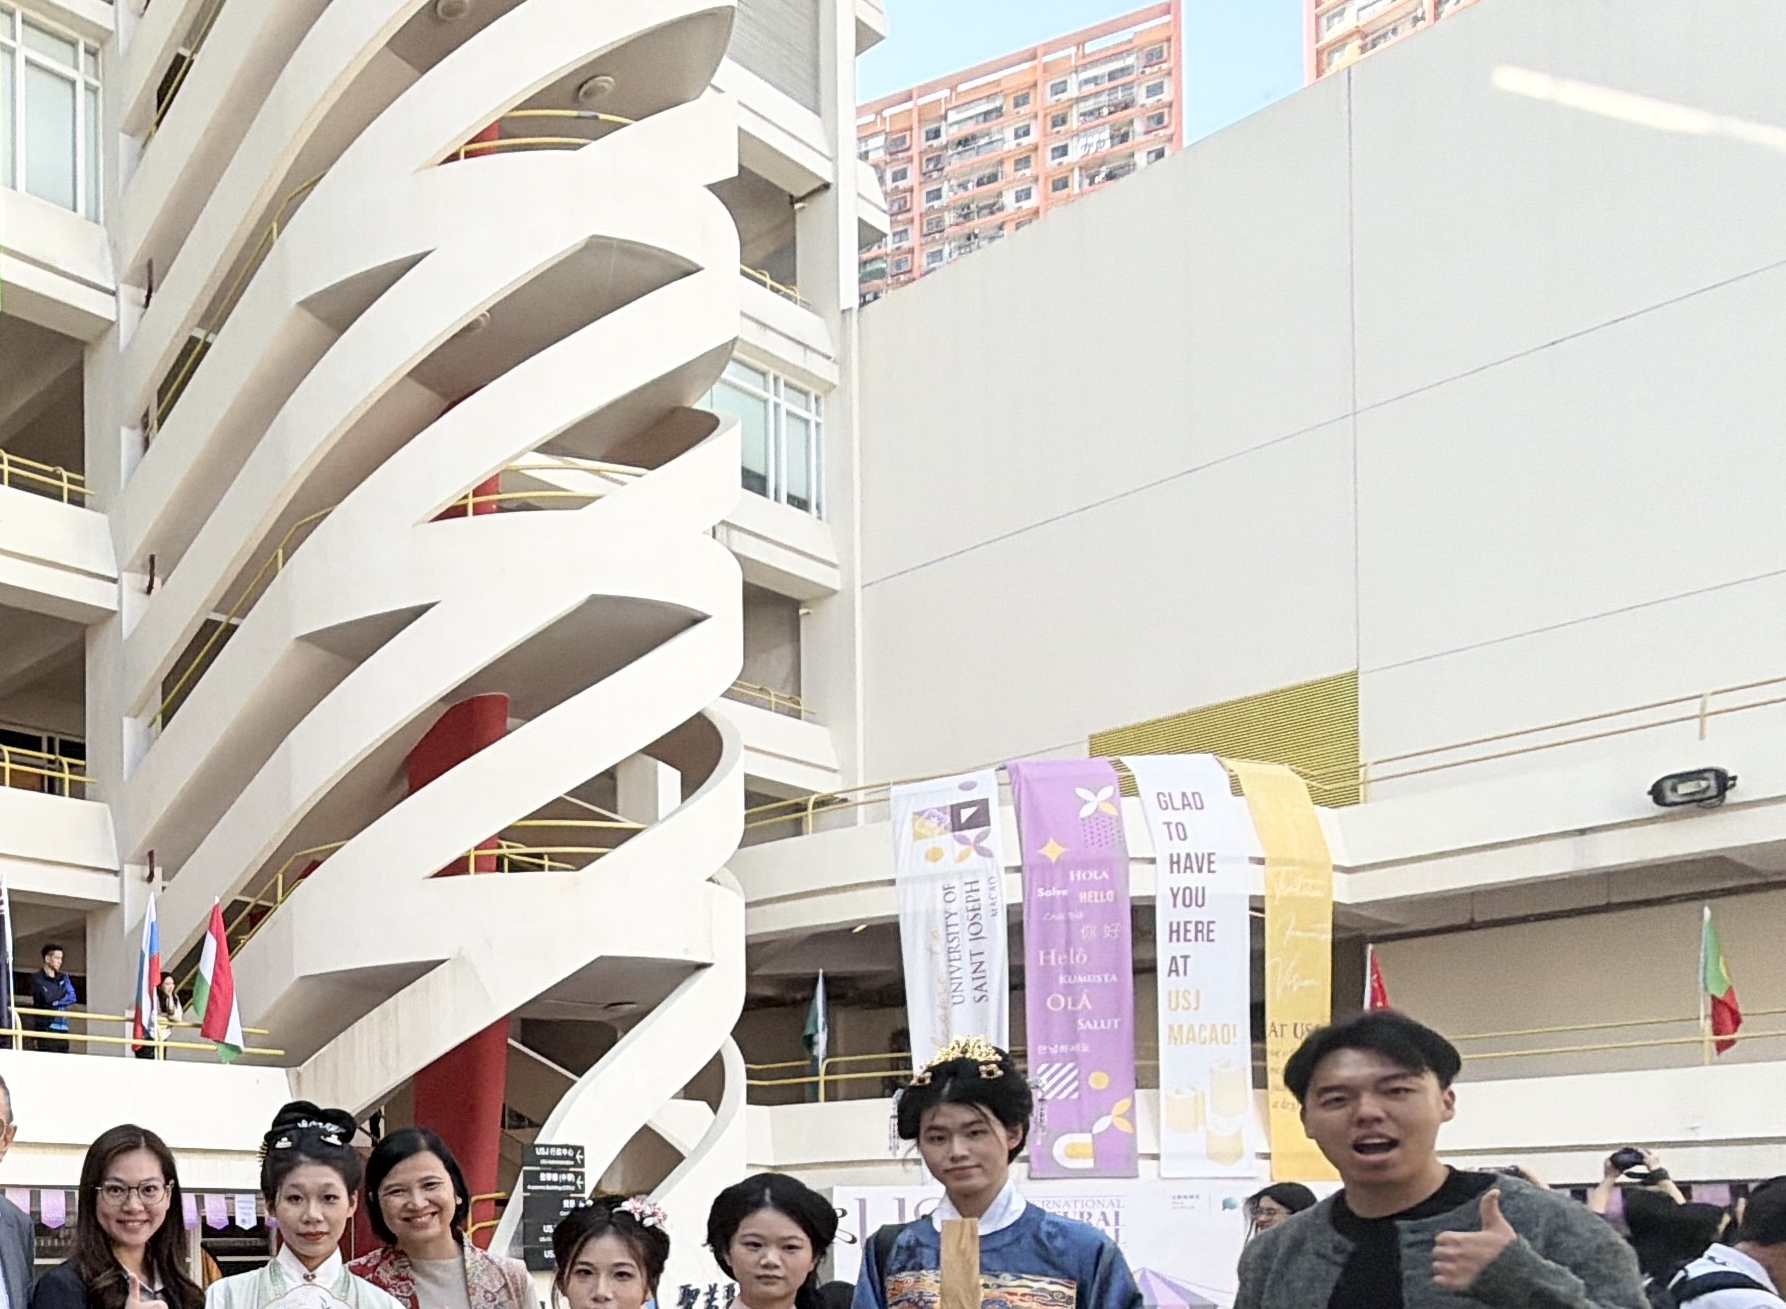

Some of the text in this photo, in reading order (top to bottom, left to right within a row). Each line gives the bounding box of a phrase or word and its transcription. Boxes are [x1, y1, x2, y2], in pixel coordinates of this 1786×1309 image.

[1156, 791, 1205, 811] GLAD
[1162, 821, 1188, 841] TO
[1169, 852, 1217, 874] HAVE
[1069, 870, 1110, 882] HOLA
[988, 876, 998, 917] MACAO
[1079, 890, 1114, 903] HELLO
[1169, 886, 1206, 909] YOU
[964, 880, 989, 1003] SAINT JOSEPH
[1168, 920, 1216, 943] HERE
[942, 884, 965, 1005] UNIVERSITY OF
[1167, 955, 1191, 977] AT
[1046, 989, 1092, 1011] OLÁ
[1167, 989, 1202, 1011] USJ
[1077, 1018, 1121, 1030] SALUT
[1167, 1023, 1237, 1045] MACAO!
[1268, 1021, 1320, 1039] AT US
[1035, 1198, 1125, 1209] RNATIONAL
